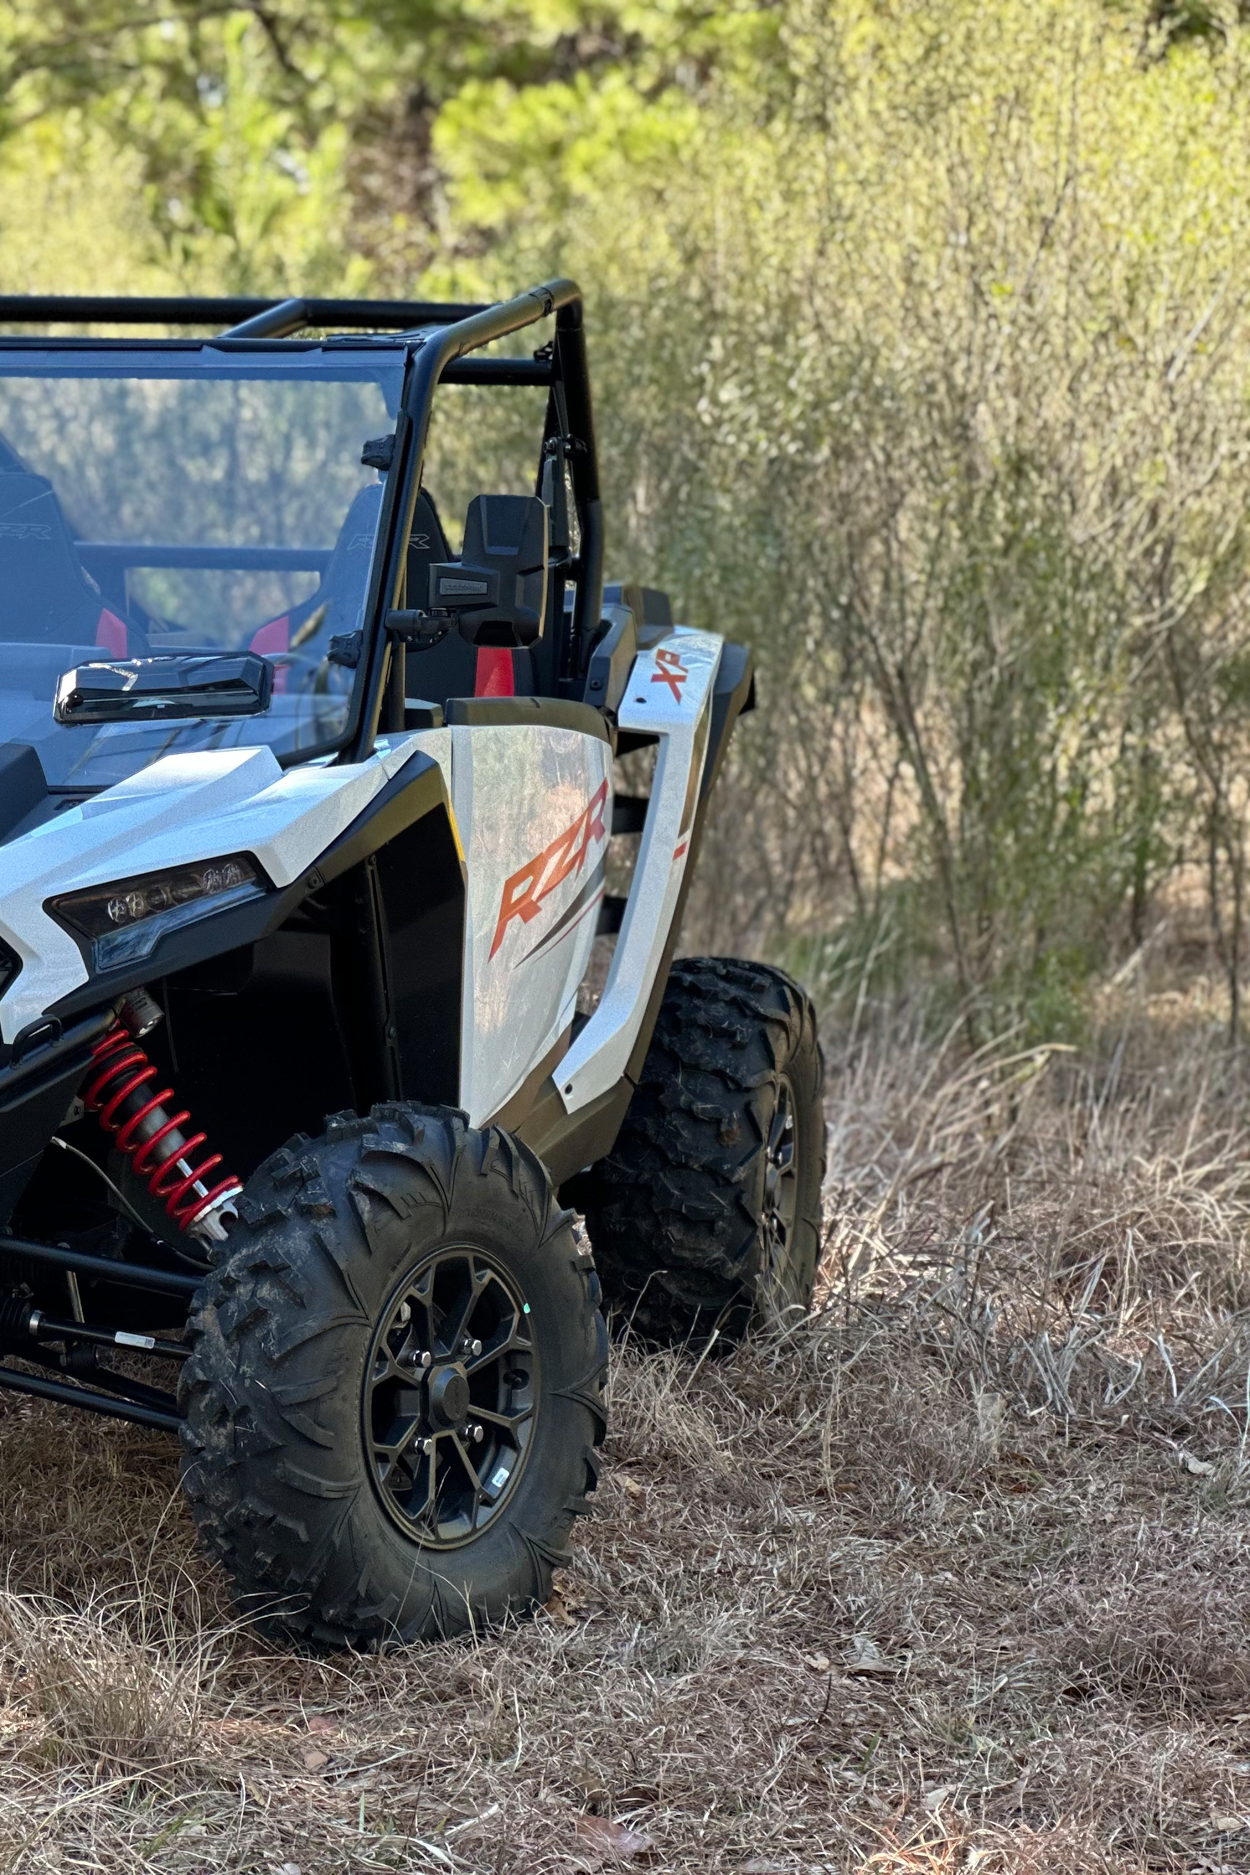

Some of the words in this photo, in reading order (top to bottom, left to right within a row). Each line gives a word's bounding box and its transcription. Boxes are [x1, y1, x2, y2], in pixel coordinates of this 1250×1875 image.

[347, 533, 430, 550] RR
[650, 648, 688, 705] XP
[487, 776, 610, 965] RZR
